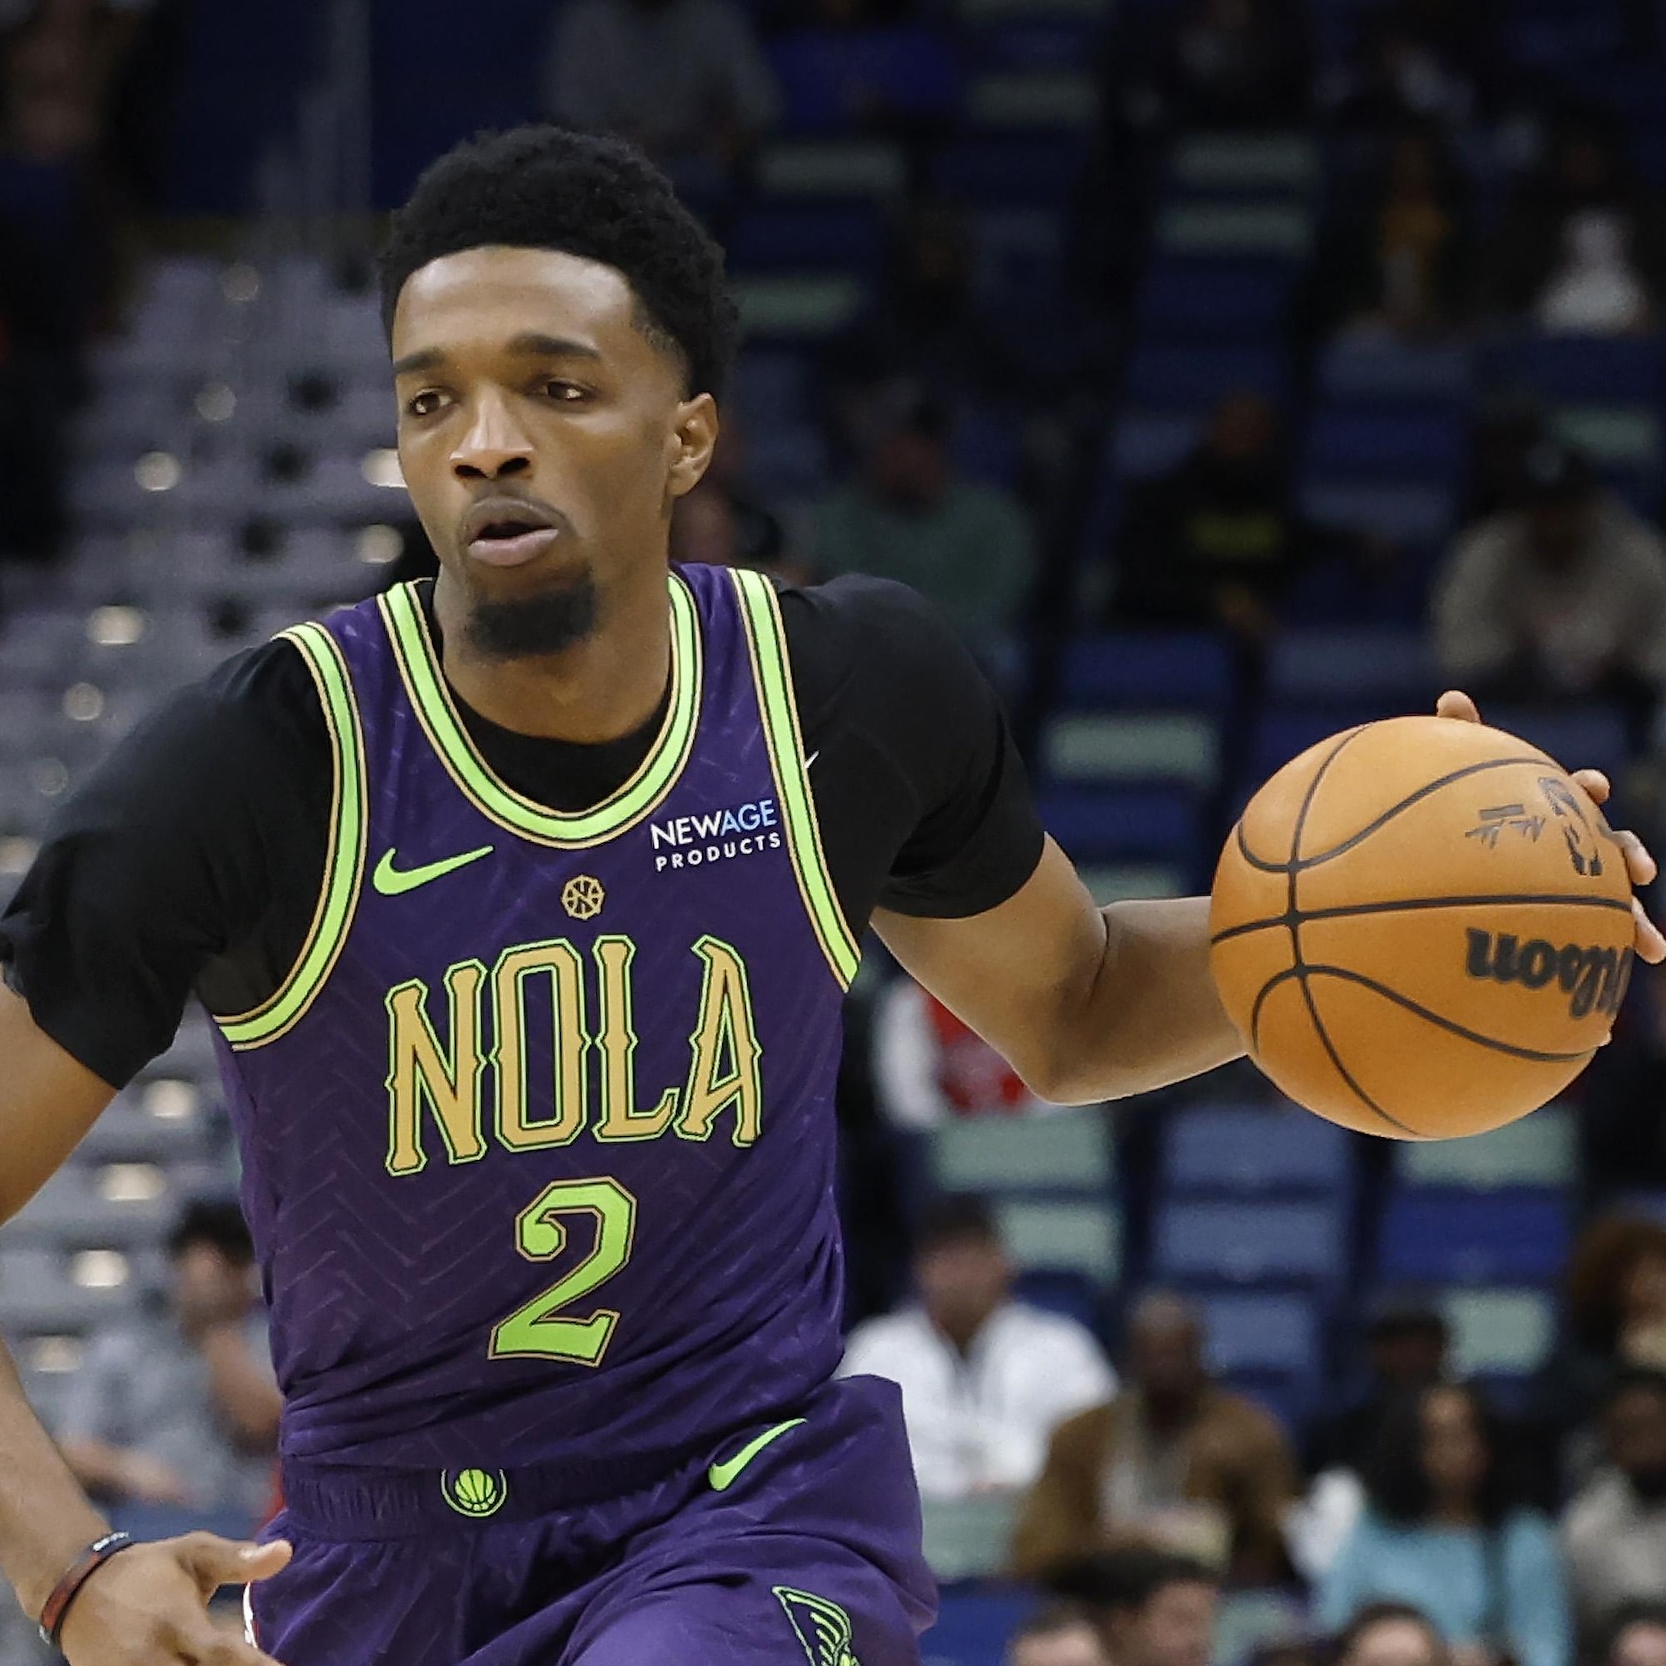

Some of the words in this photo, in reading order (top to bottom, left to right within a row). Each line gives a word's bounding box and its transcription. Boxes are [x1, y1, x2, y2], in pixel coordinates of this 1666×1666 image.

[650, 799, 777, 850] NEWAGE
[655, 832, 781, 872] PRODUCTS
[385, 935, 762, 1176] NOLA
[488, 1176, 636, 1367] 2
